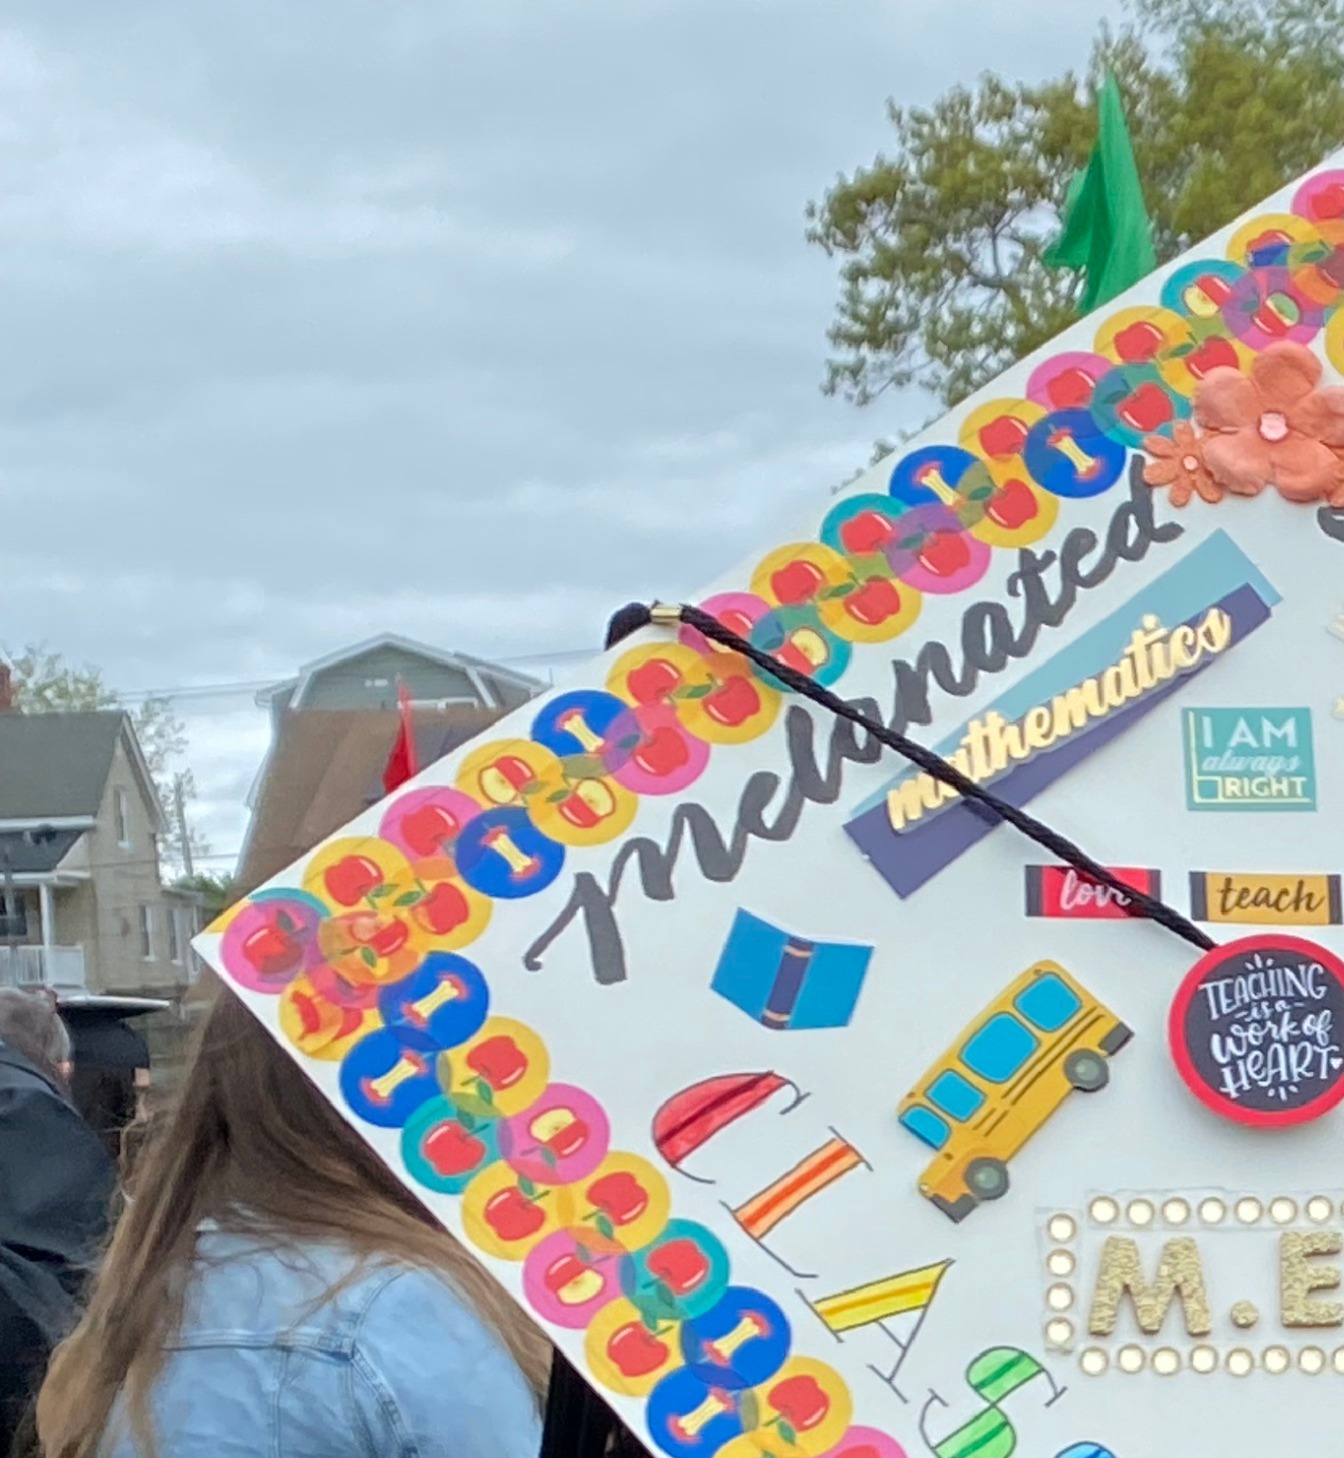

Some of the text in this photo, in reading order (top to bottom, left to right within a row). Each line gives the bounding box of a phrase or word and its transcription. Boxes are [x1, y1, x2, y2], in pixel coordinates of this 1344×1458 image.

[1202, 715, 1297, 748] I AM
[1201, 749, 1301, 777] always
[1224, 776, 1307, 797] RIGHT
[1217, 877, 1325, 914] teach
[1198, 963, 1327, 1021] TEACHING
[1211, 1009, 1333, 1064] work of
